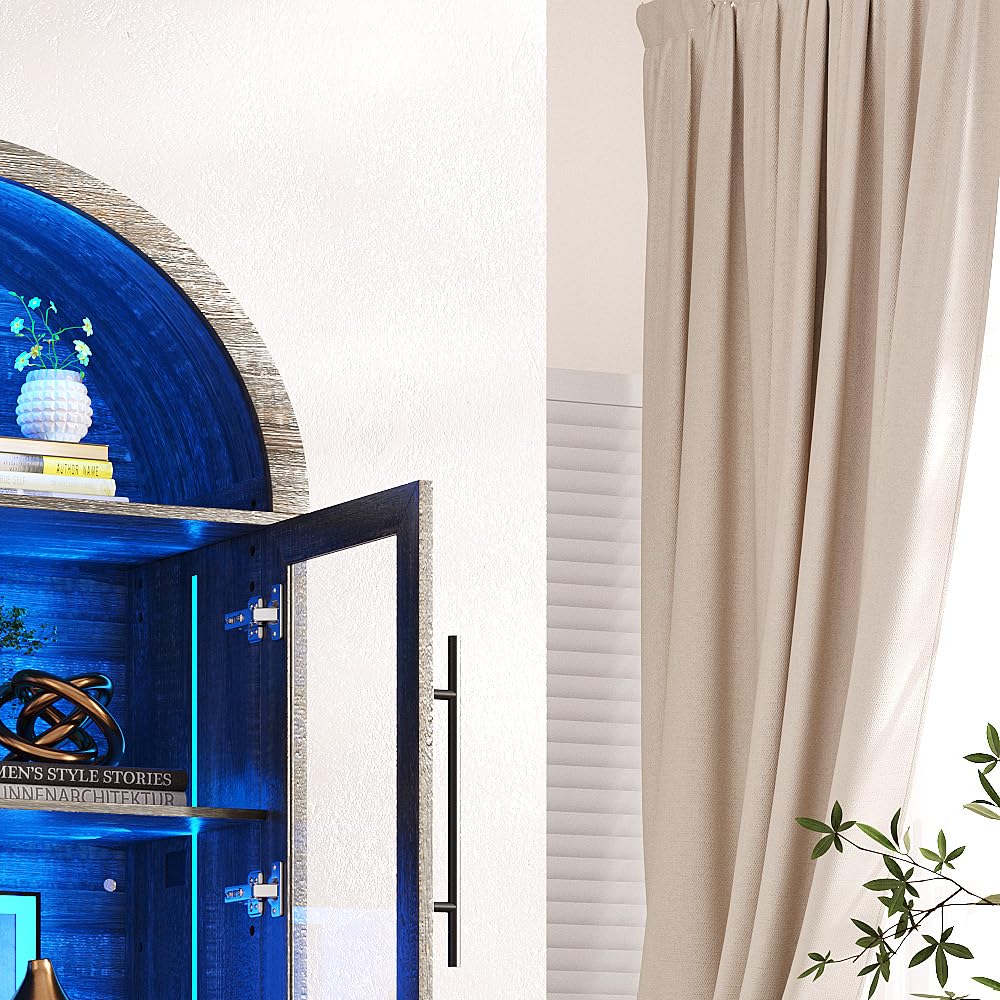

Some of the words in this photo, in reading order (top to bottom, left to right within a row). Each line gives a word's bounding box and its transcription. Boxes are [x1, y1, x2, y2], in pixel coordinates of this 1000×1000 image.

[56, 463, 79, 475] AUTHOR
[82, 465, 99, 477] NAME
[47, 766, 99, 784] STYLE
[102, 769, 172, 787] STORIES
